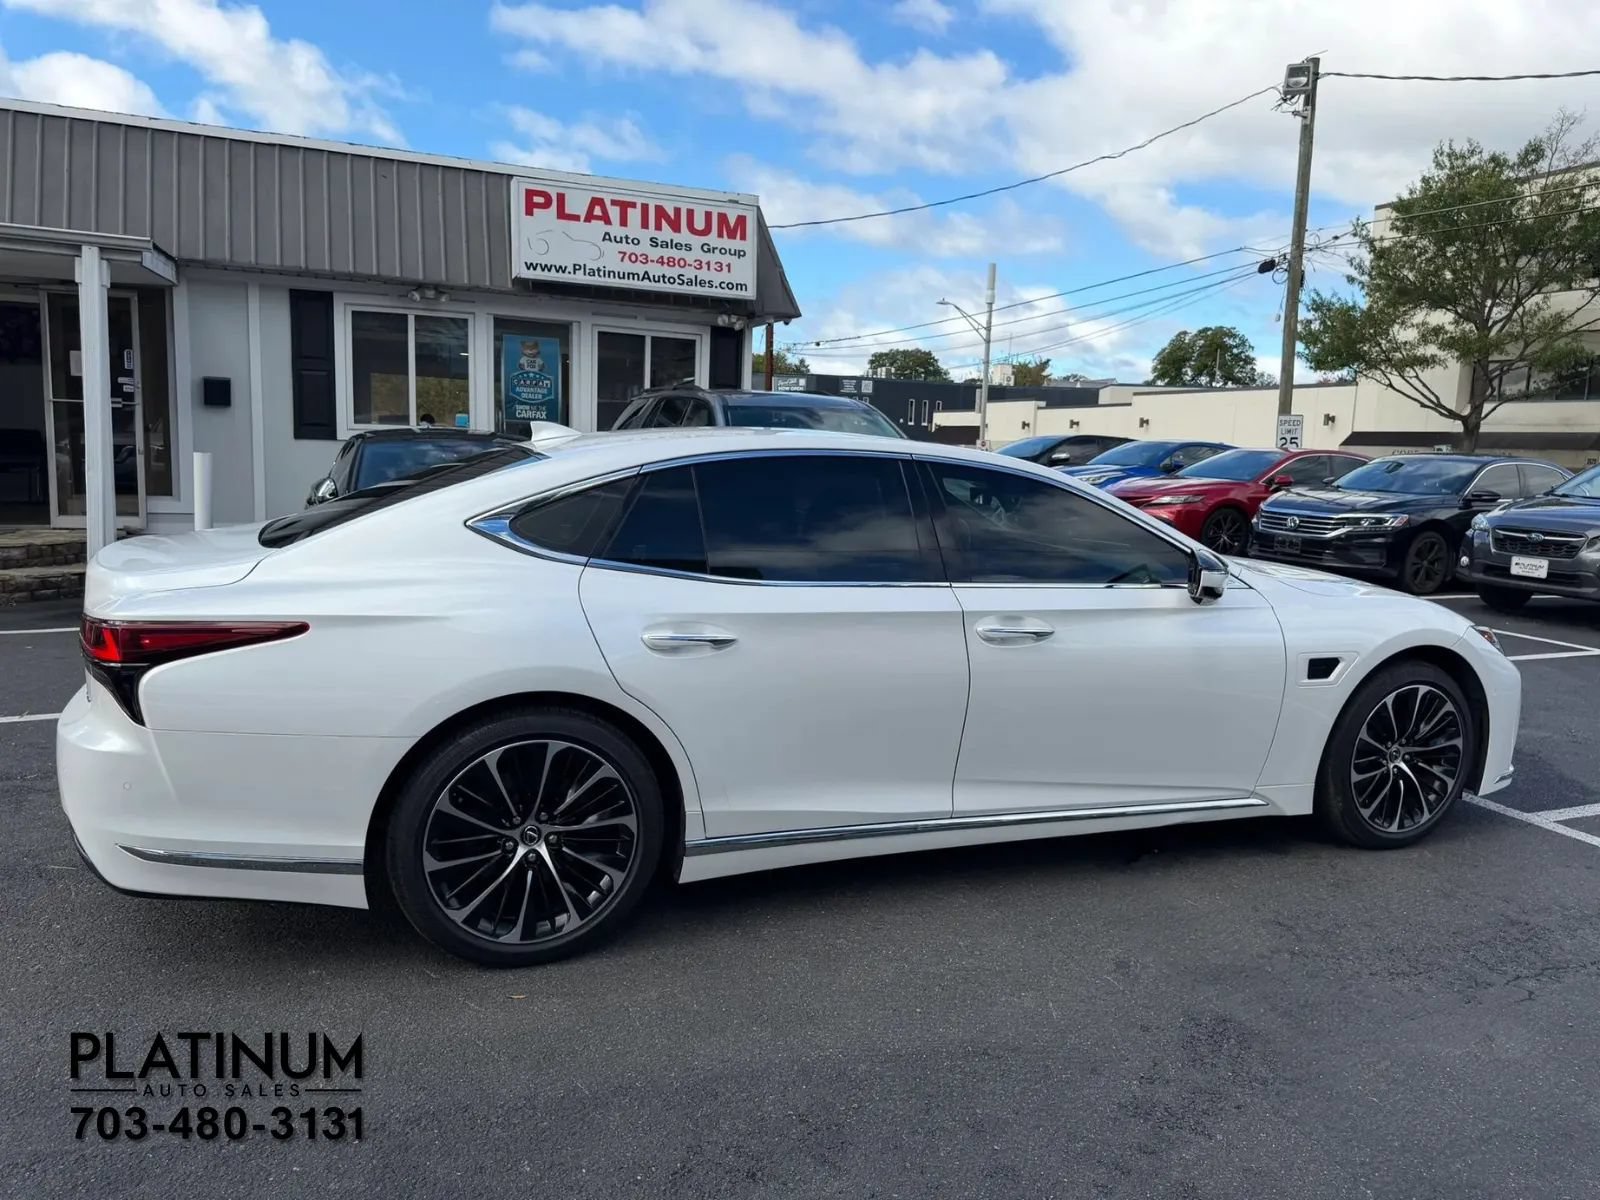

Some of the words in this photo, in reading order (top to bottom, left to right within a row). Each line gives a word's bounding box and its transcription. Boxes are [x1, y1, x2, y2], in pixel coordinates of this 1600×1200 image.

[525, 188, 747, 241] PLATINUM
[602, 232, 641, 246] Auto
[649, 237, 693, 252] Sales
[700, 243, 747, 259] Group
[617, 251, 732, 273] 703-480-3131
[524, 261, 748, 292] www.PlatinumAutoSales.com
[515, 410, 547, 419] CARFAX
[1279, 437, 1299, 448] 25
